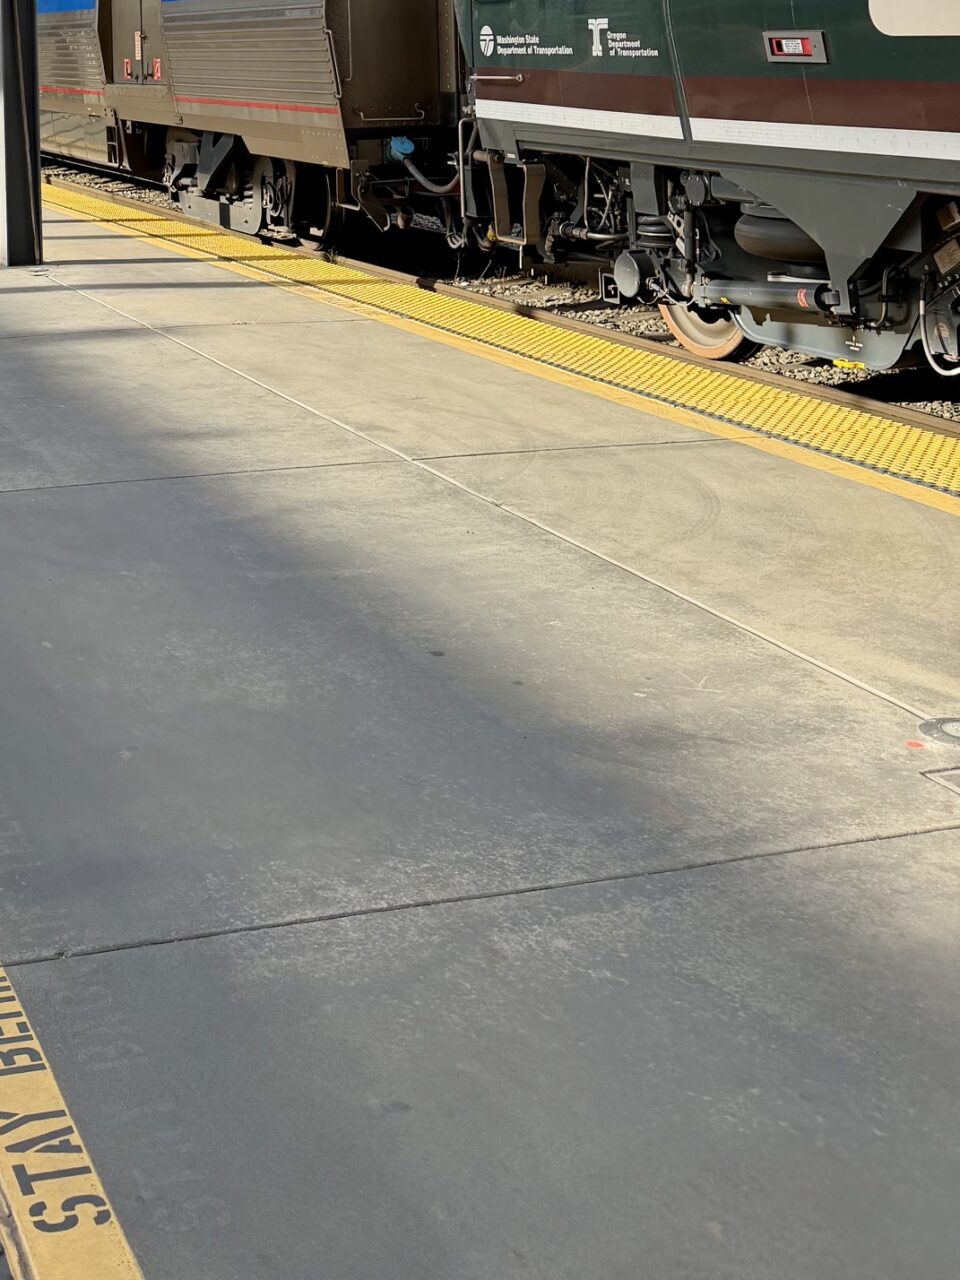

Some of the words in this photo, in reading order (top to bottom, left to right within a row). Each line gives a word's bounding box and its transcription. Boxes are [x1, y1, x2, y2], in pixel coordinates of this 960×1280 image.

[496, 35, 525, 45] Washington
[525, 34, 540, 44] State
[607, 31, 627, 41] Oregon
[608, 40, 641, 49] Department
[497, 45, 527, 56] Department
[527, 45, 533, 55] of
[533, 45, 574, 56] Transportation
[610, 48, 616, 57] of
[617, 47, 659, 58] Transportation
